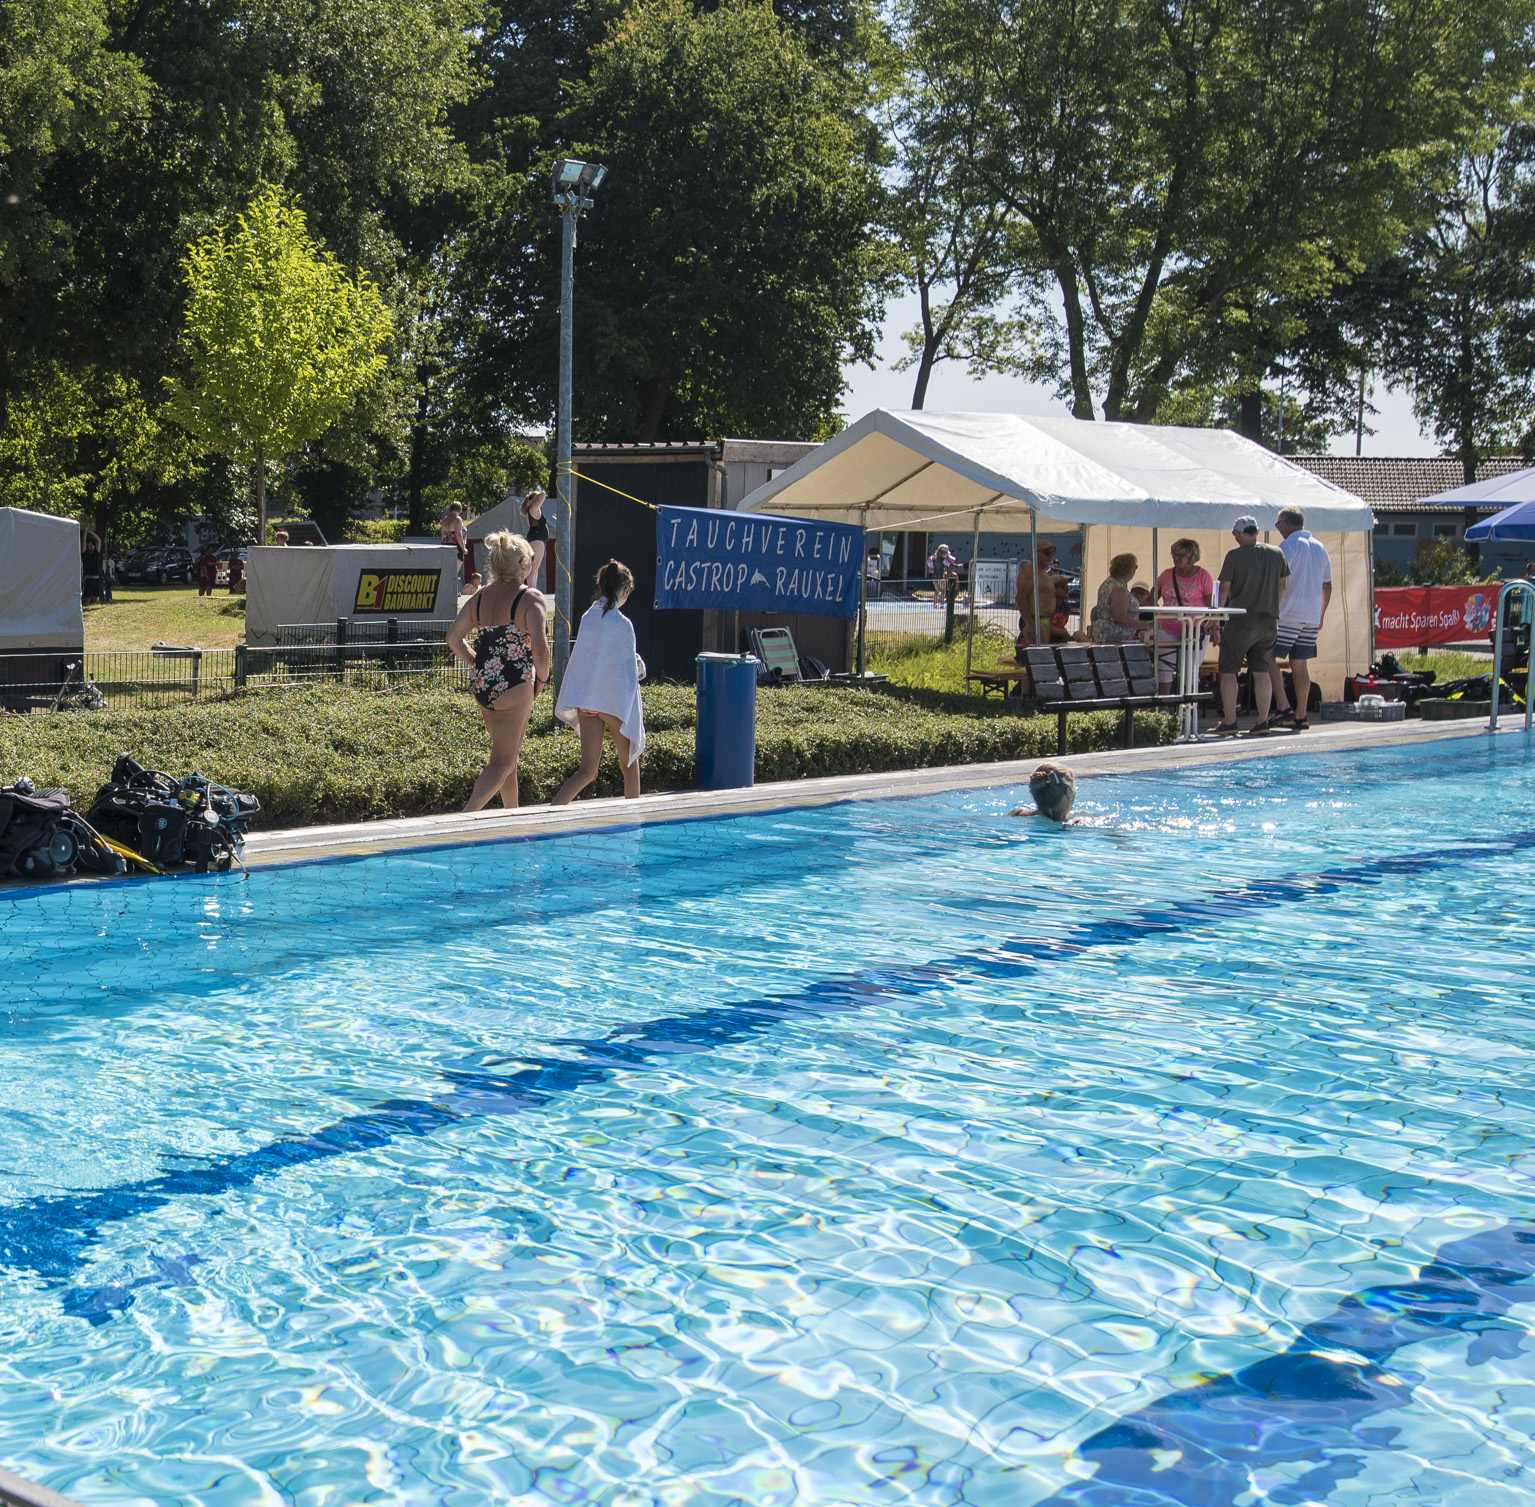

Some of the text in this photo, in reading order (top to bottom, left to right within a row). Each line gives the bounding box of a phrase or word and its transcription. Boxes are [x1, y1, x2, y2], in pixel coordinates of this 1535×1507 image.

[670, 518, 852, 564] TAUCHVEREIN
[356, 574, 388, 610] B1
[387, 574, 439, 593] DISCOUNT
[664, 559, 844, 602] CASTROP RAUXEL
[384, 593, 435, 610] BAUMARKT
[1382, 611, 1409, 630] macht
[1409, 611, 1439, 632] Sparen
